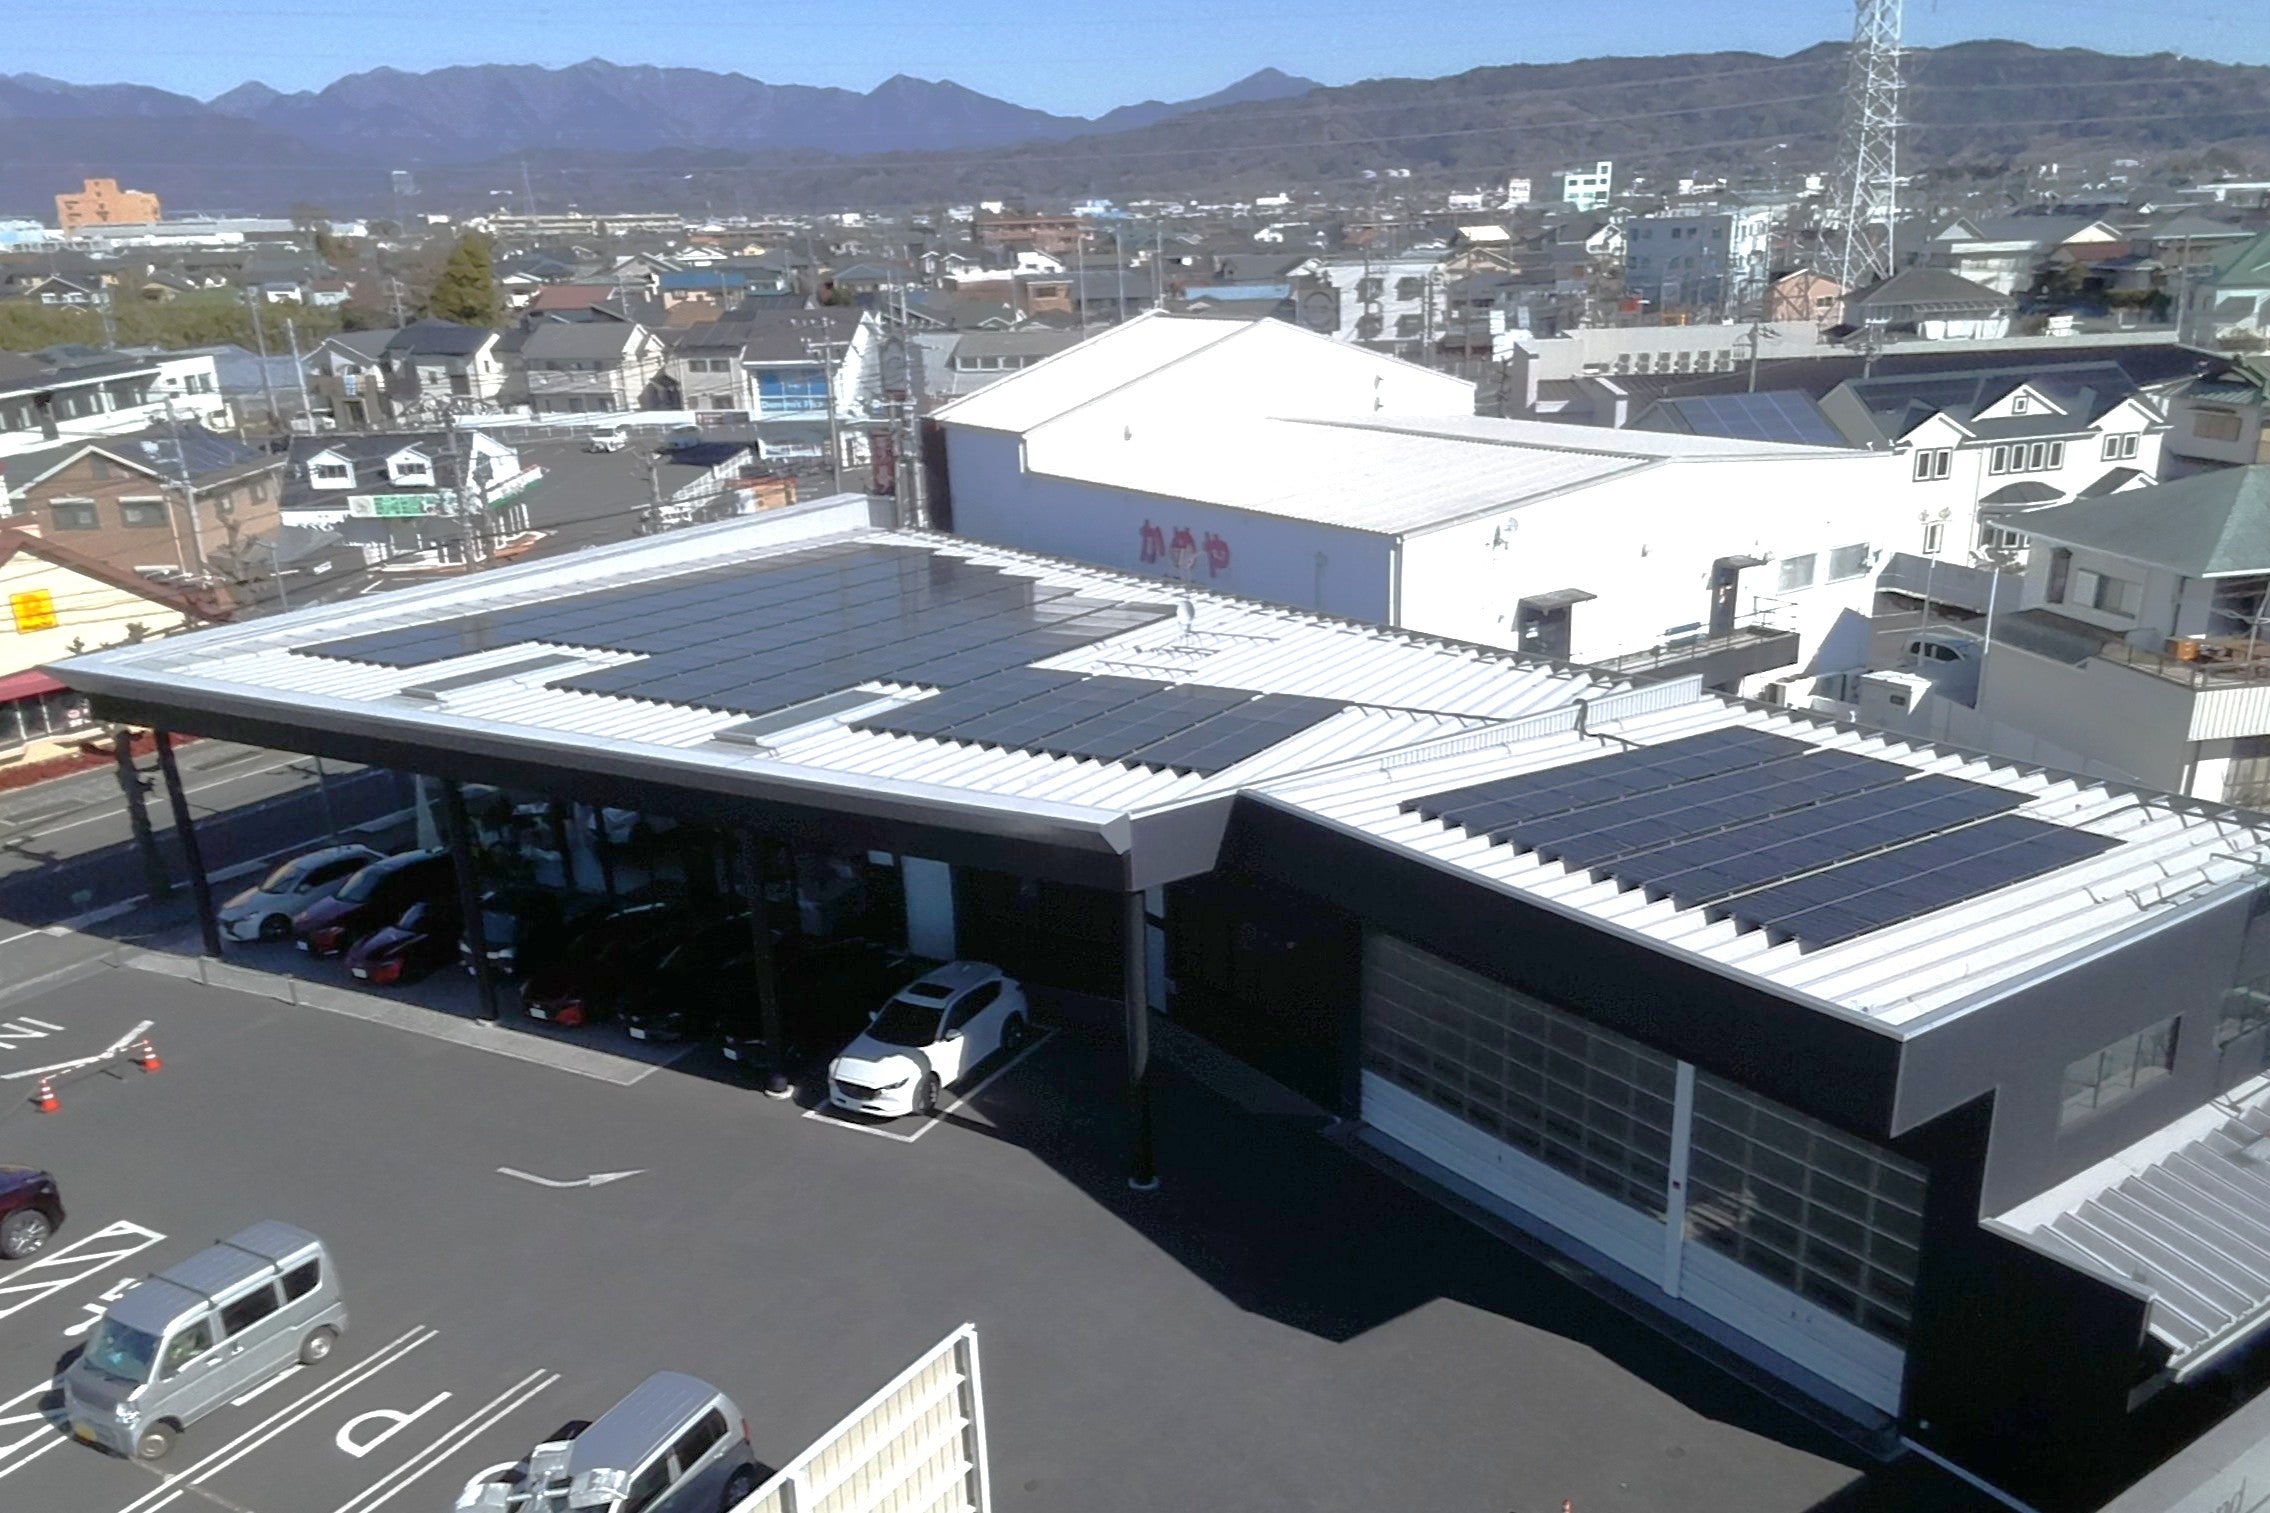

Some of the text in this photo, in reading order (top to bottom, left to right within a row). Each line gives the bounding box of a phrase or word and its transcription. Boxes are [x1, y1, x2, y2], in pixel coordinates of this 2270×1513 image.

[1140, 519, 1230, 578] かめや
[336, 1391, 454, 1458] P
